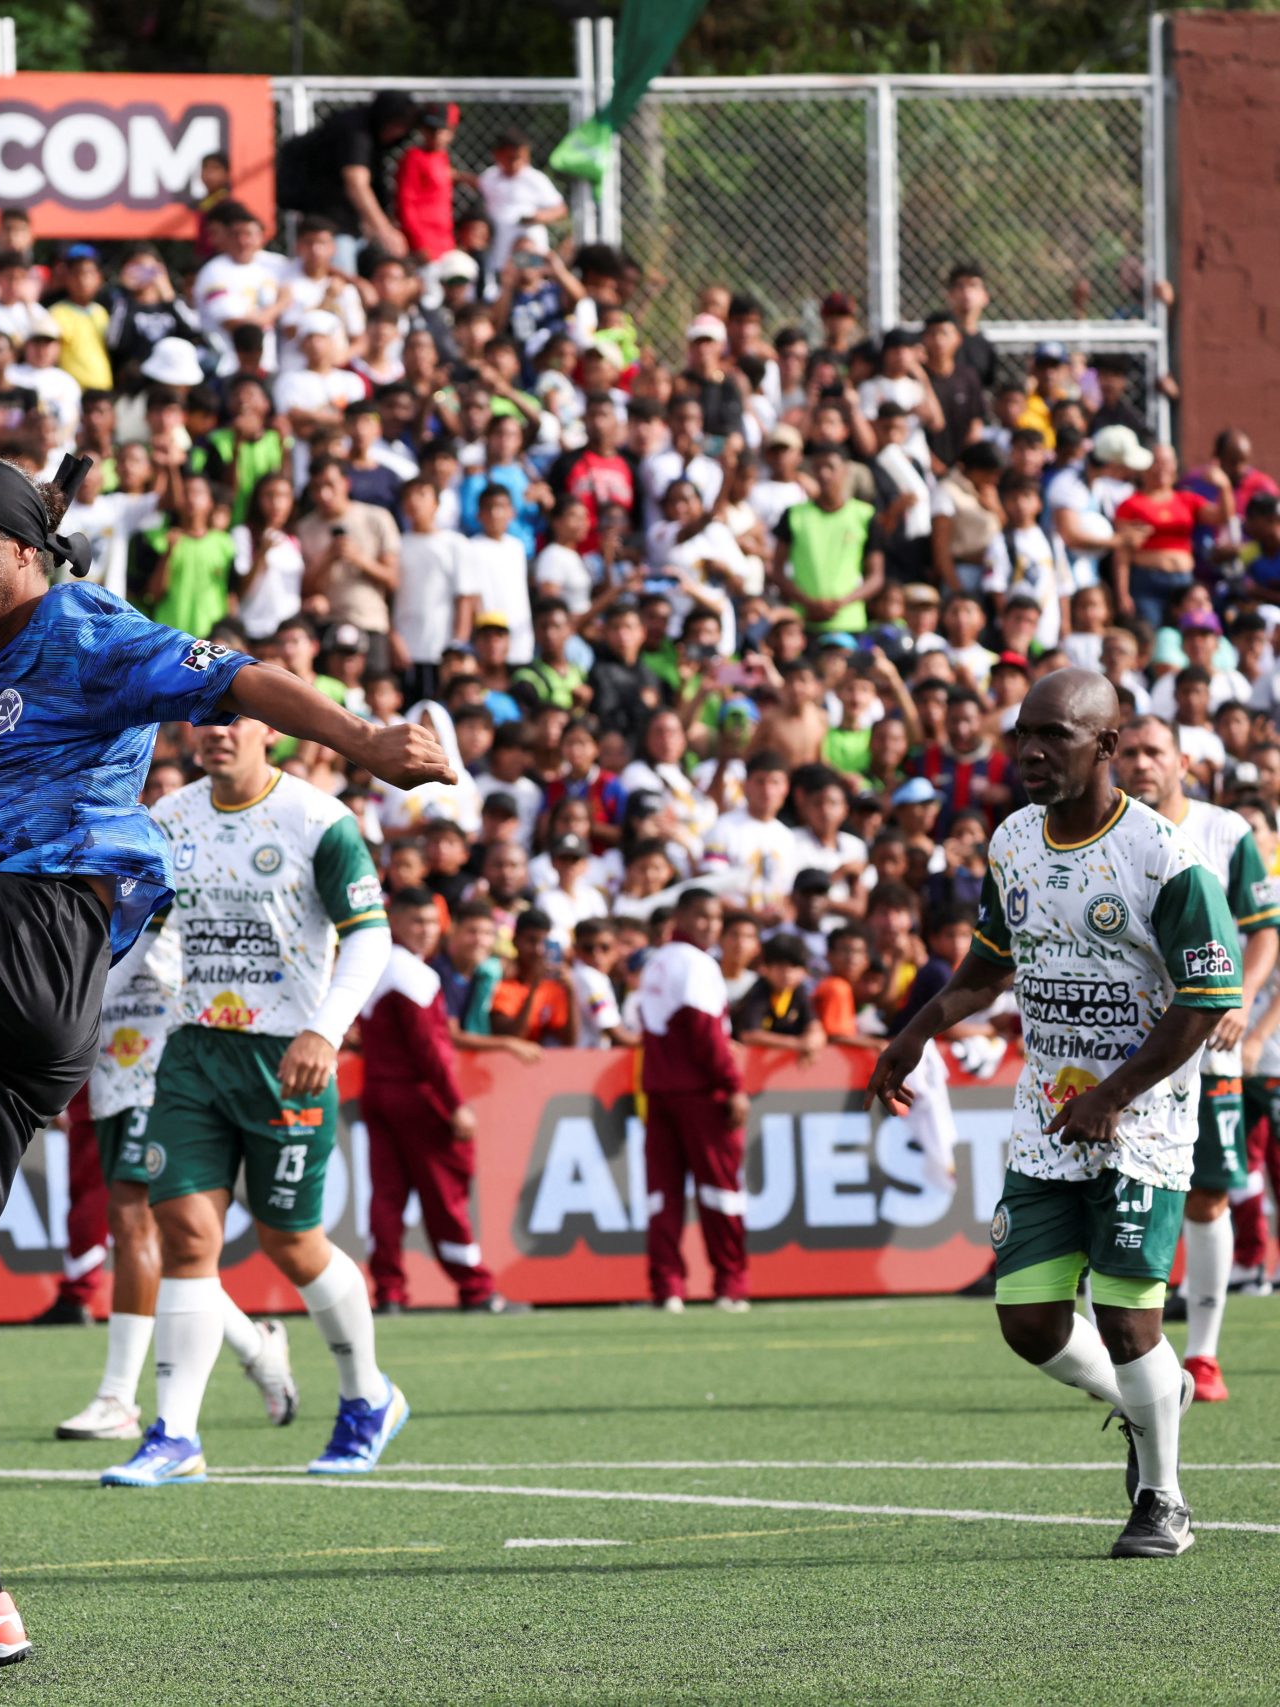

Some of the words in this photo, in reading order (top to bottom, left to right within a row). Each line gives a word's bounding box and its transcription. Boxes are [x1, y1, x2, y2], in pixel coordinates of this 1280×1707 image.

[1046, 875, 1070, 889] RS
[184, 938, 279, 956] OYAL.COM
[1023, 979, 1128, 1004] APUESTAS
[198, 1008, 261, 1026] KALY
[1028, 1028, 1130, 1061] MultiMax
[274, 1144, 308, 1183] 13
[528, 1108, 1022, 1234] AUEST
[1115, 1233, 1143, 1249] RS
